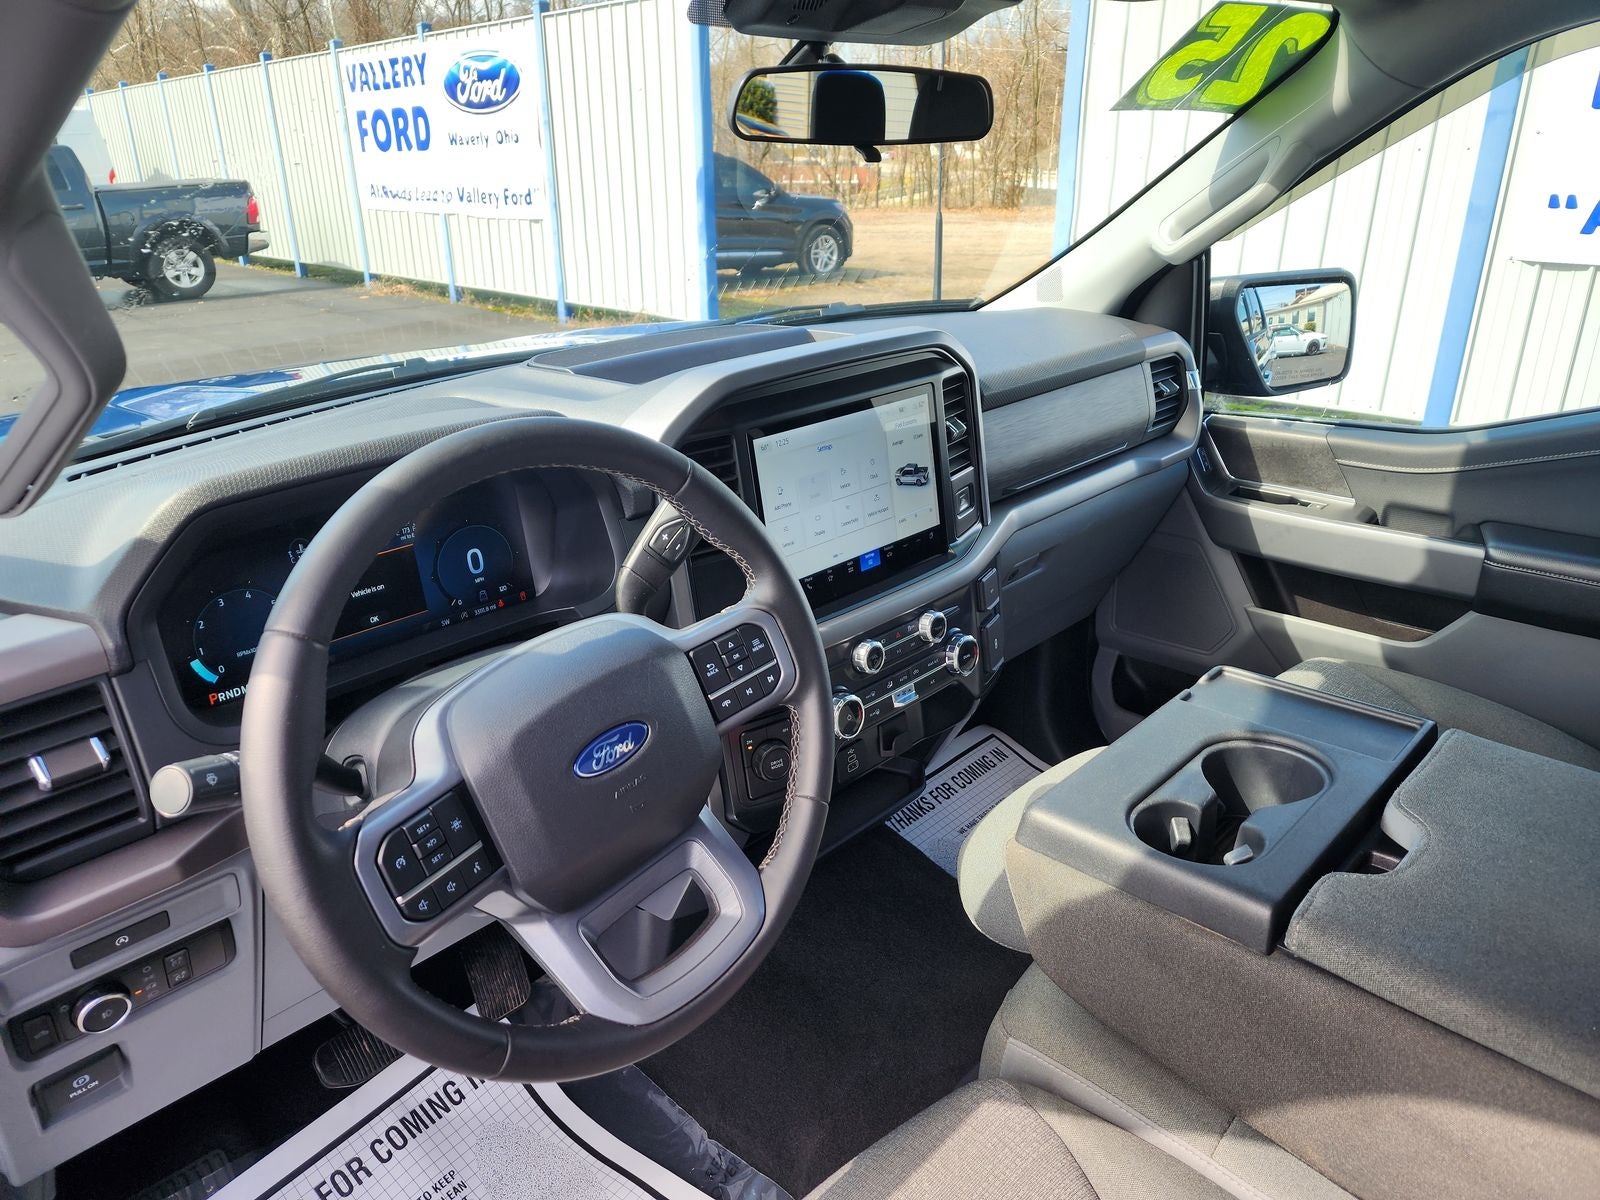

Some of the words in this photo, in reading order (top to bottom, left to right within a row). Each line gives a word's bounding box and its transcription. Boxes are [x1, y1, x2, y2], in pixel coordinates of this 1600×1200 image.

[346, 52, 427, 93] VALLERY
[356, 105, 431, 152] FORD
[448, 131, 489, 148] Waverly
[496, 130, 519, 144] Ohio
[456, 187, 499, 209] Vallery
[467, 548, 484, 574] 0
[245, 590, 252, 599] 4
[350, 588, 372, 598] Vehicle
[376, 583, 385, 591] on
[217, 598, 225, 607] 3
[198, 620, 205, 629] 2
[369, 615, 380, 623] OK
[198, 647, 204, 656] 1
[751, 643, 765, 652] MENU
[218, 665, 225, 673] 0
[706, 668, 719, 677] BACK
[887, 796, 936, 833] THANKS
[928, 782, 958, 805] FOR
[951, 754, 998, 789] COMING
[990, 746, 1010, 763] IN
[69, 1085, 89, 1099] PULL
[87, 1080, 99, 1090] ON
[314, 1156, 373, 1200] FOR
[369, 1080, 466, 1164] COMING
[431, 1169, 456, 1194] KEEP
